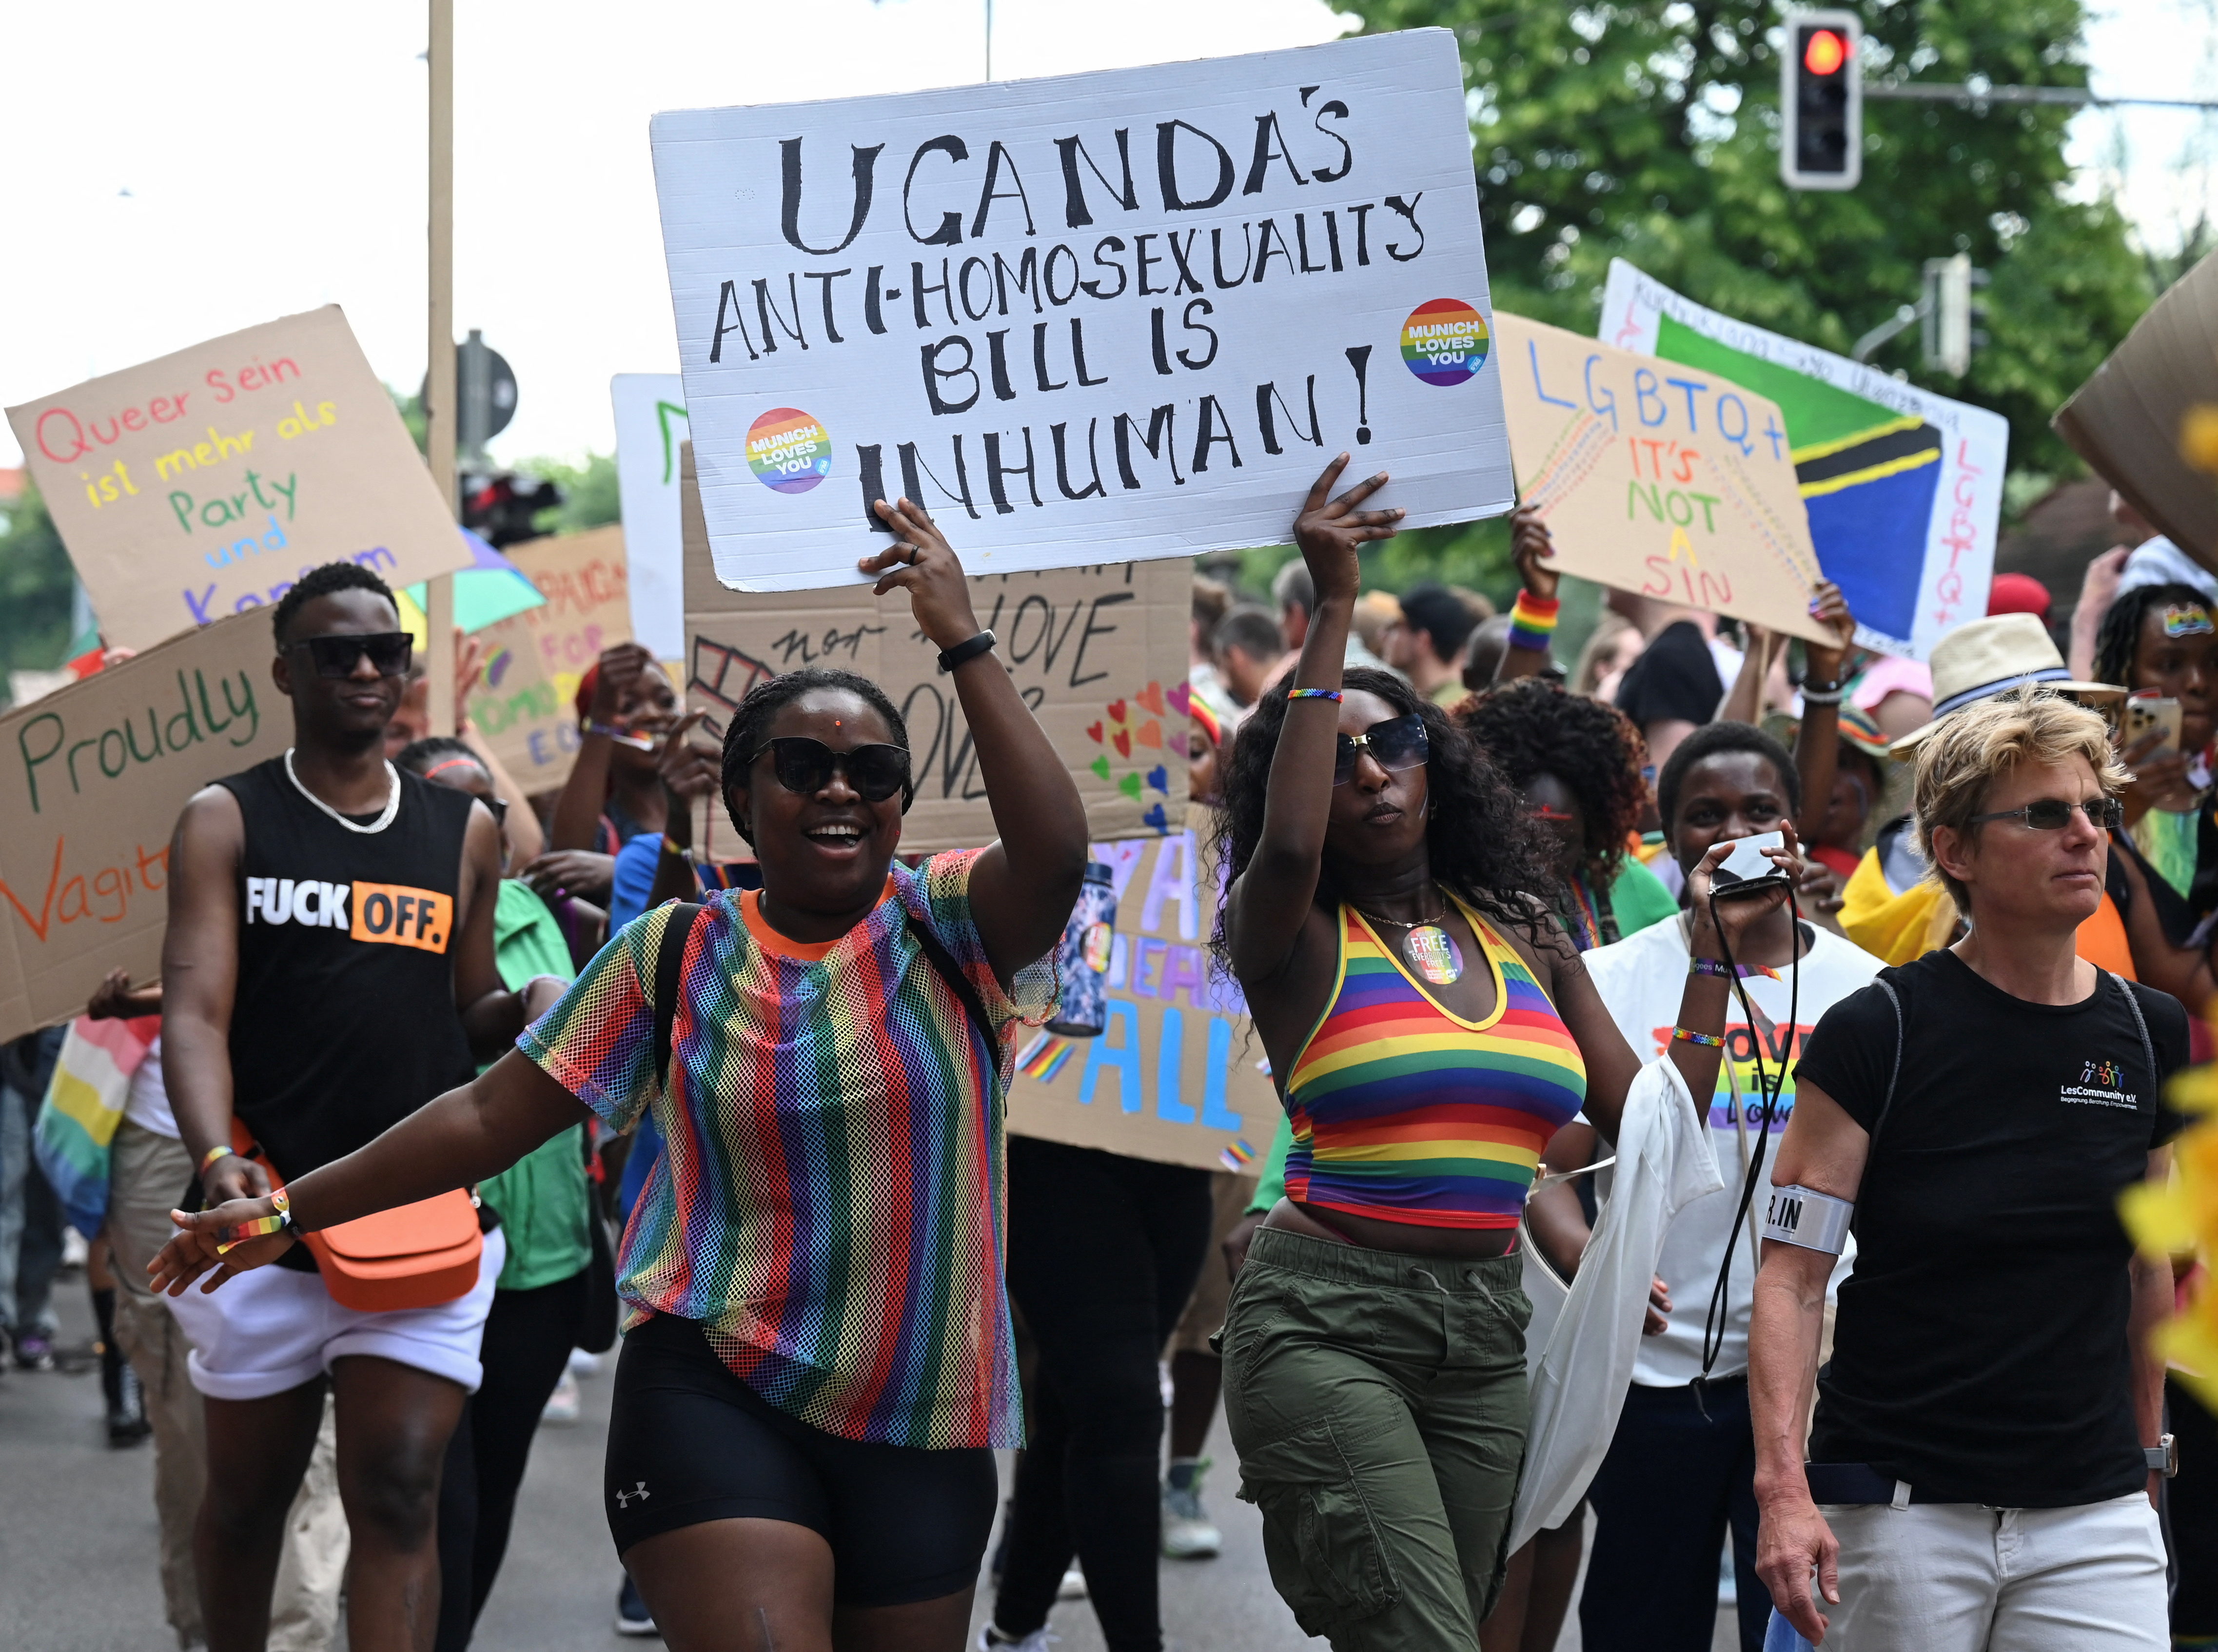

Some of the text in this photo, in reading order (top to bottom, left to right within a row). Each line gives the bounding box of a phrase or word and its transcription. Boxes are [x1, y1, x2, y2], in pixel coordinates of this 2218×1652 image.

[779, 85, 1352, 255] UGANDA'S
[710, 192, 1425, 364] ANTI-HOMOSEXUALITY
[1409, 320, 1479, 338] MUNICH
[1415, 335, 1474, 353] LOVES
[920, 298, 1218, 415] BILL IS
[1427, 351, 1465, 366] YOU
[1529, 338, 1785, 460] LGBTQ+
[36, 392, 190, 463] Queer
[751, 424, 818, 453] MUNICH
[80, 400, 338, 509] ist mehr als
[761, 440, 818, 465] LOVES
[775, 456, 812, 475] YOU
[1629, 436, 1701, 483] IT'S
[168, 469, 297, 535] Party
[1628, 478, 1722, 533] NOT
[204, 515, 288, 570] und
[1669, 526, 1698, 566] A
[1642, 554, 1733, 606] SIN
[19, 668, 260, 814] Proudly
[247, 876, 443, 945] FUCK OFF.
[1410, 934, 1449, 954] FREE
[1425, 959, 1445, 968] FREE
[1078, 998, 1243, 1132] ALL
[1752, 1067, 1779, 1092] is
[2061, 1085, 2125, 1103] LesCommunity
[2061, 1096, 2089, 1105] Begegnung.
[2089, 1099, 2110, 1107] Beratung.
